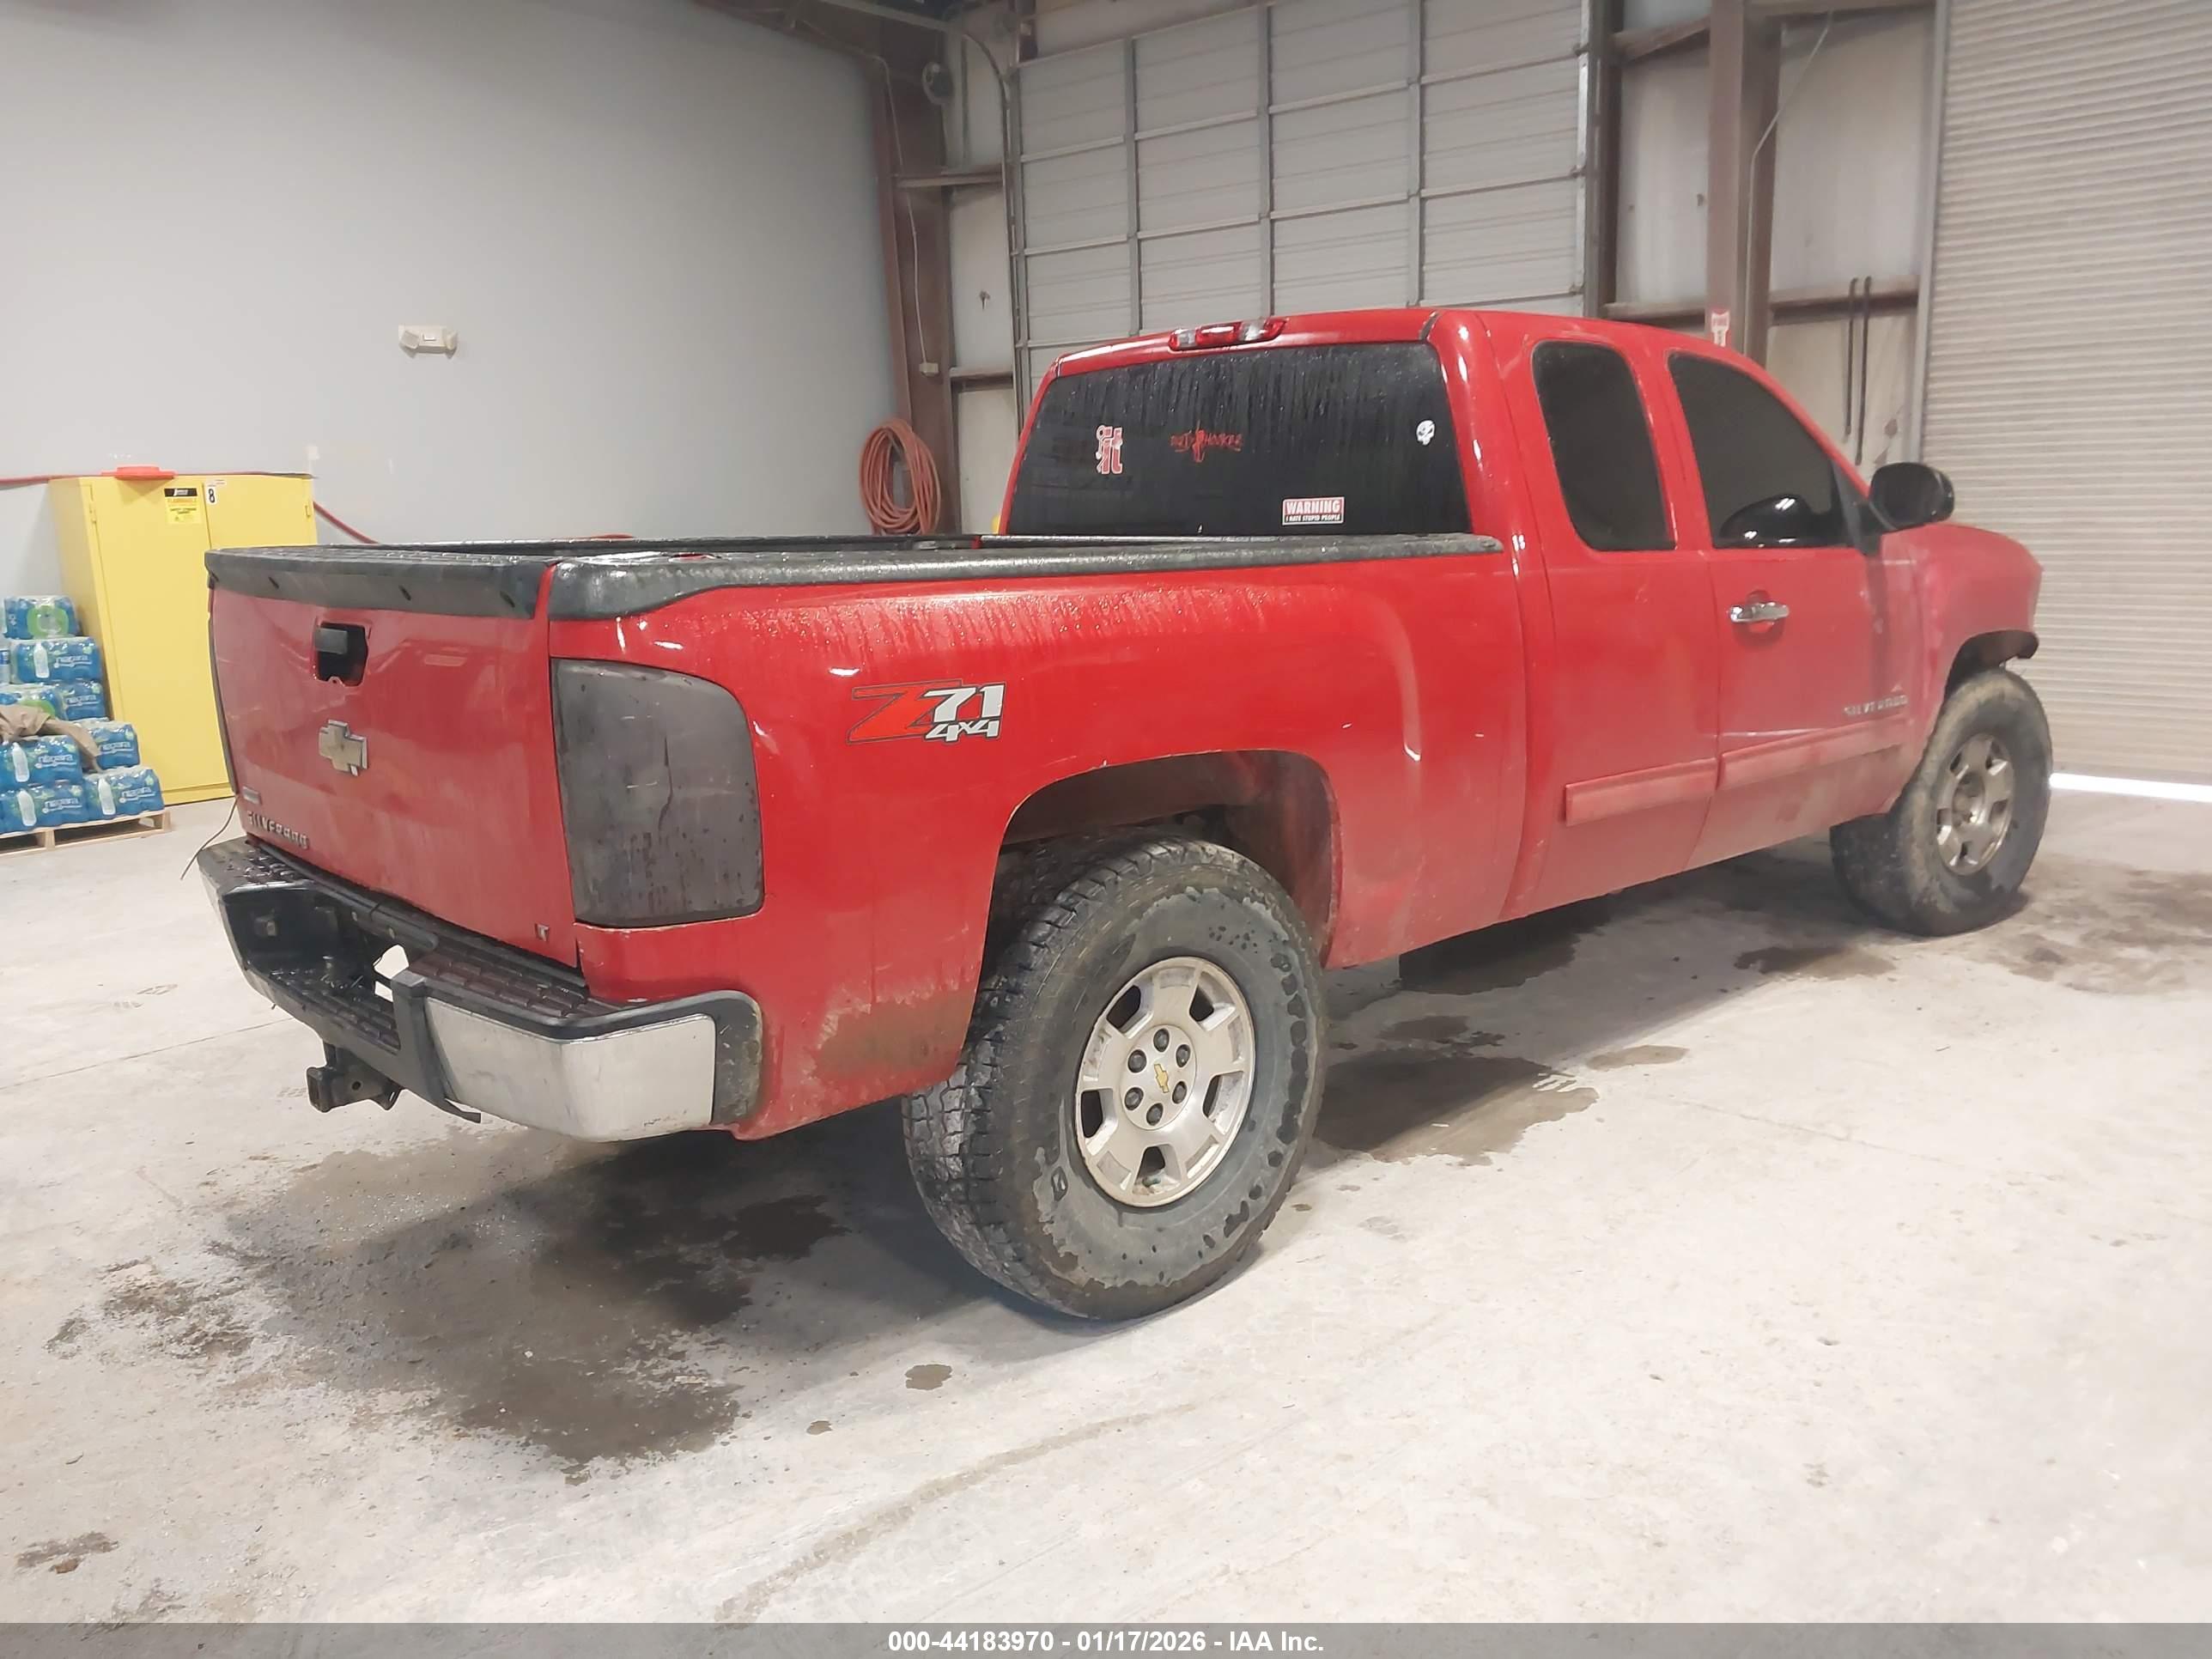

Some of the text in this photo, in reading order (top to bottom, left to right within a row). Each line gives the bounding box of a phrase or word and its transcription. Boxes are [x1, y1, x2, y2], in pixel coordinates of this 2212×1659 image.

[209, 488, 216, 503] 8
[1286, 501, 1340, 514] WARNING
[846, 678, 1006, 744] Z71
